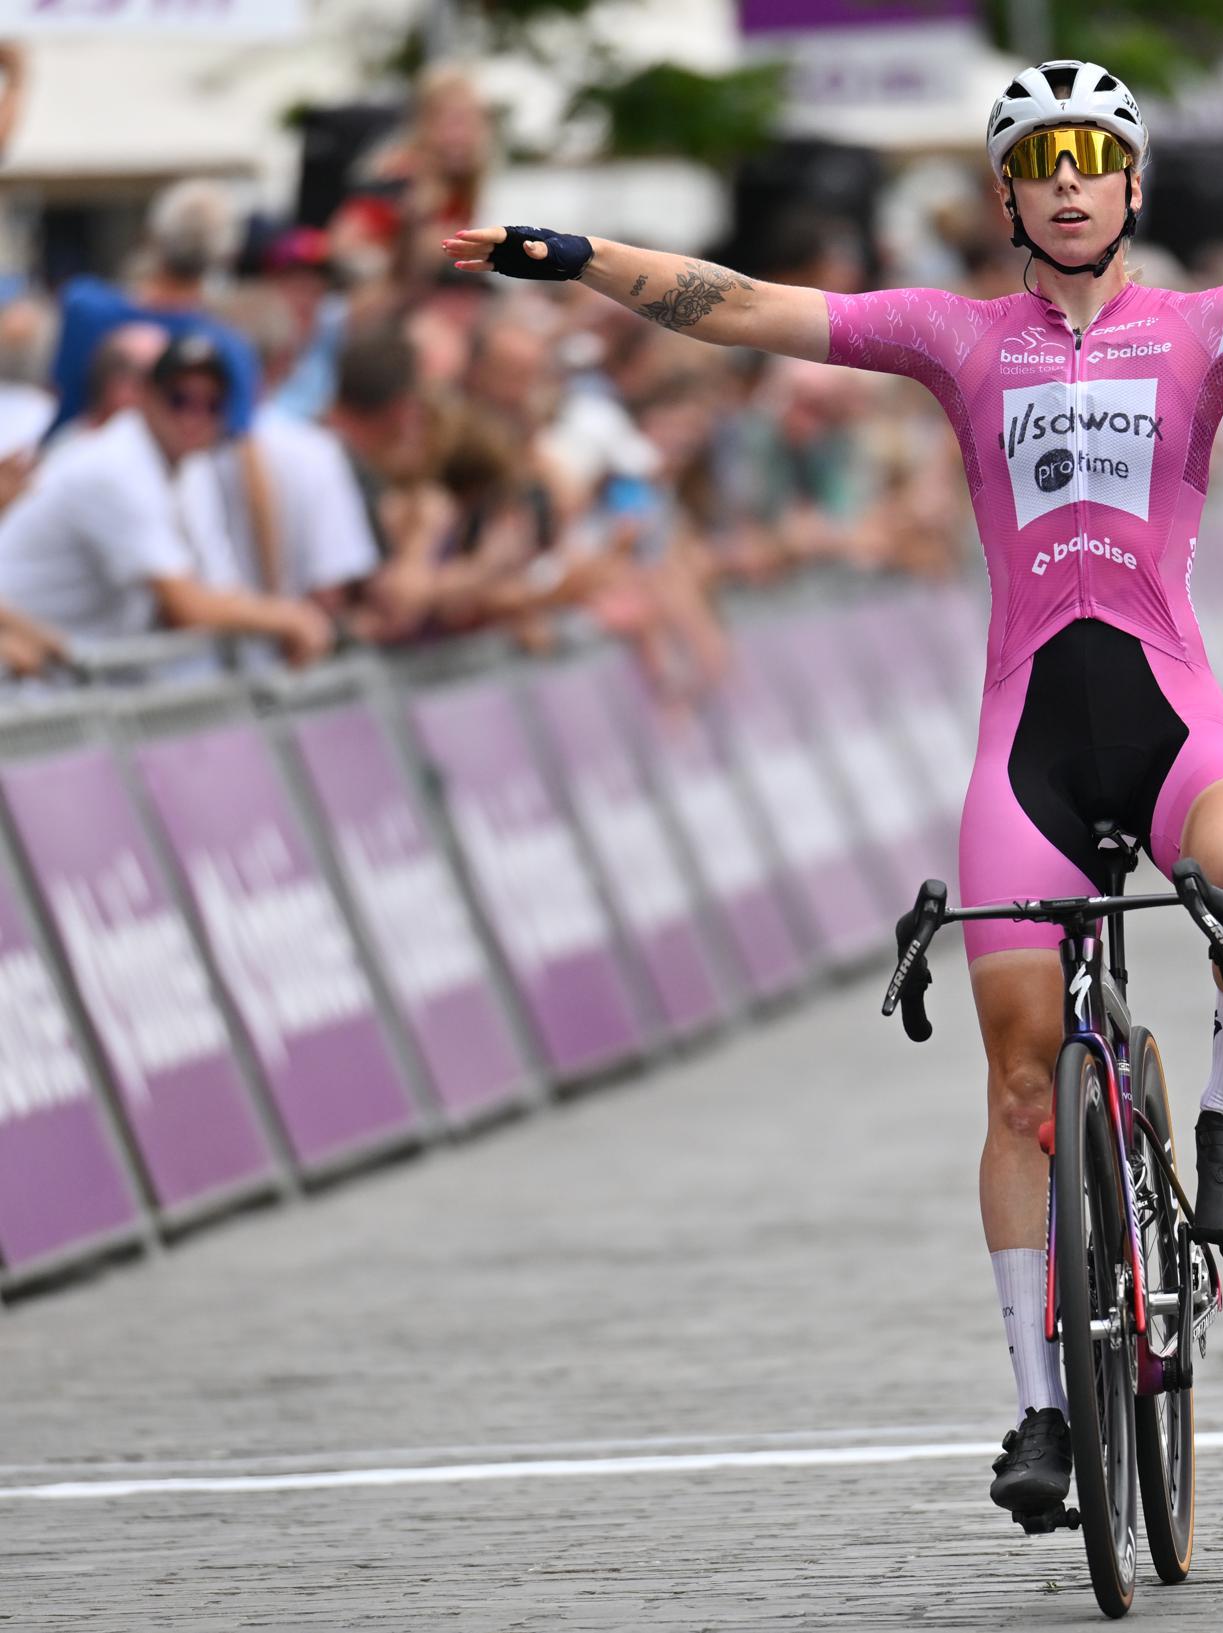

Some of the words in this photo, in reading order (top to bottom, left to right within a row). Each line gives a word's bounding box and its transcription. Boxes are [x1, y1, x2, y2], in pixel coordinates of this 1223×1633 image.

[1090, 320, 1145, 336] CRAFT
[1000, 349, 1066, 364] baloise
[1107, 341, 1173, 360] baloise
[999, 364, 1036, 376] ladies
[1053, 532, 1138, 570] baloise
[888, 938, 921, 1000] SRAM
